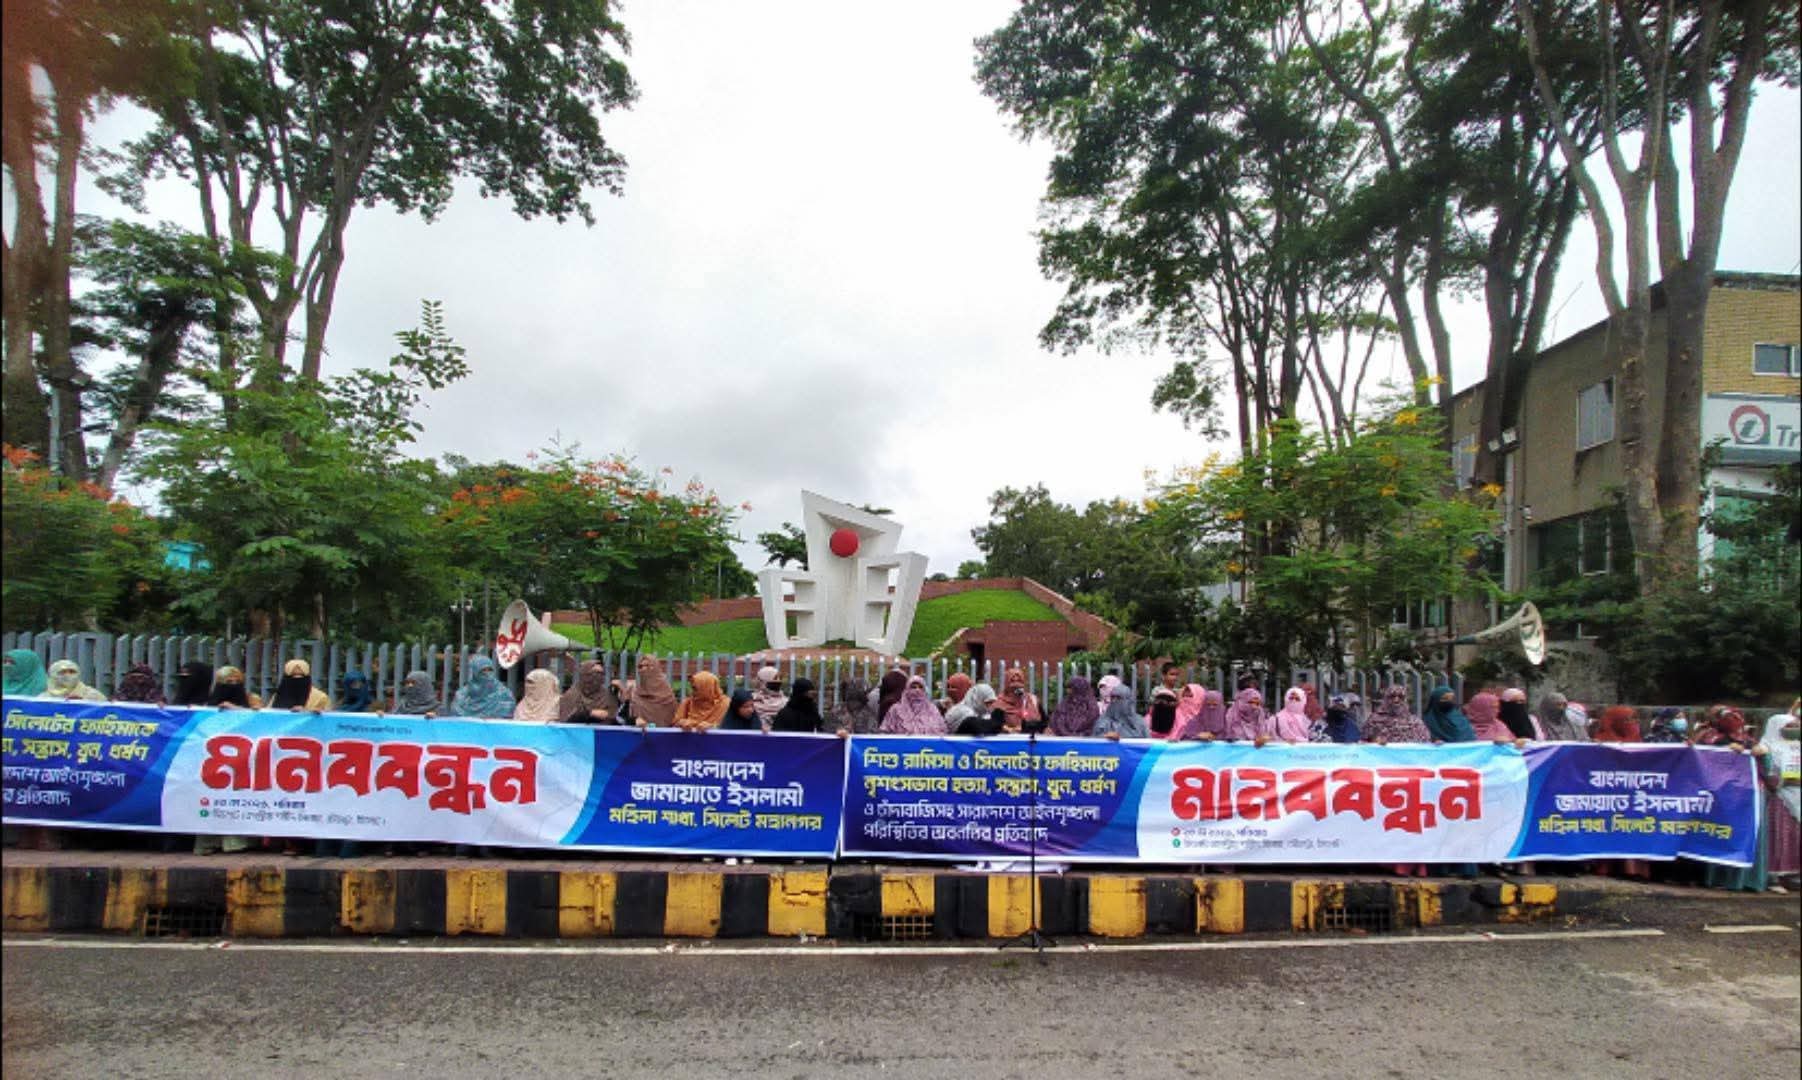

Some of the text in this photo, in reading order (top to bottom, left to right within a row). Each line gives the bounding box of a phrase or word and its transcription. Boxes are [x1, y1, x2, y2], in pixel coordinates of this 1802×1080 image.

[672, 759, 765, 780] বাংলাদেশ
[957, 755, 969, 770] ও
[201, 736, 539, 816] মানববন্ধন
[1589, 771, 1669, 789] বাংলাদেশ
[631, 781, 804, 807] জামায়াতে ইসলামী
[1171, 767, 1483, 834] মানববন্ধন
[1634, 790, 1714, 813] ইসলামী
